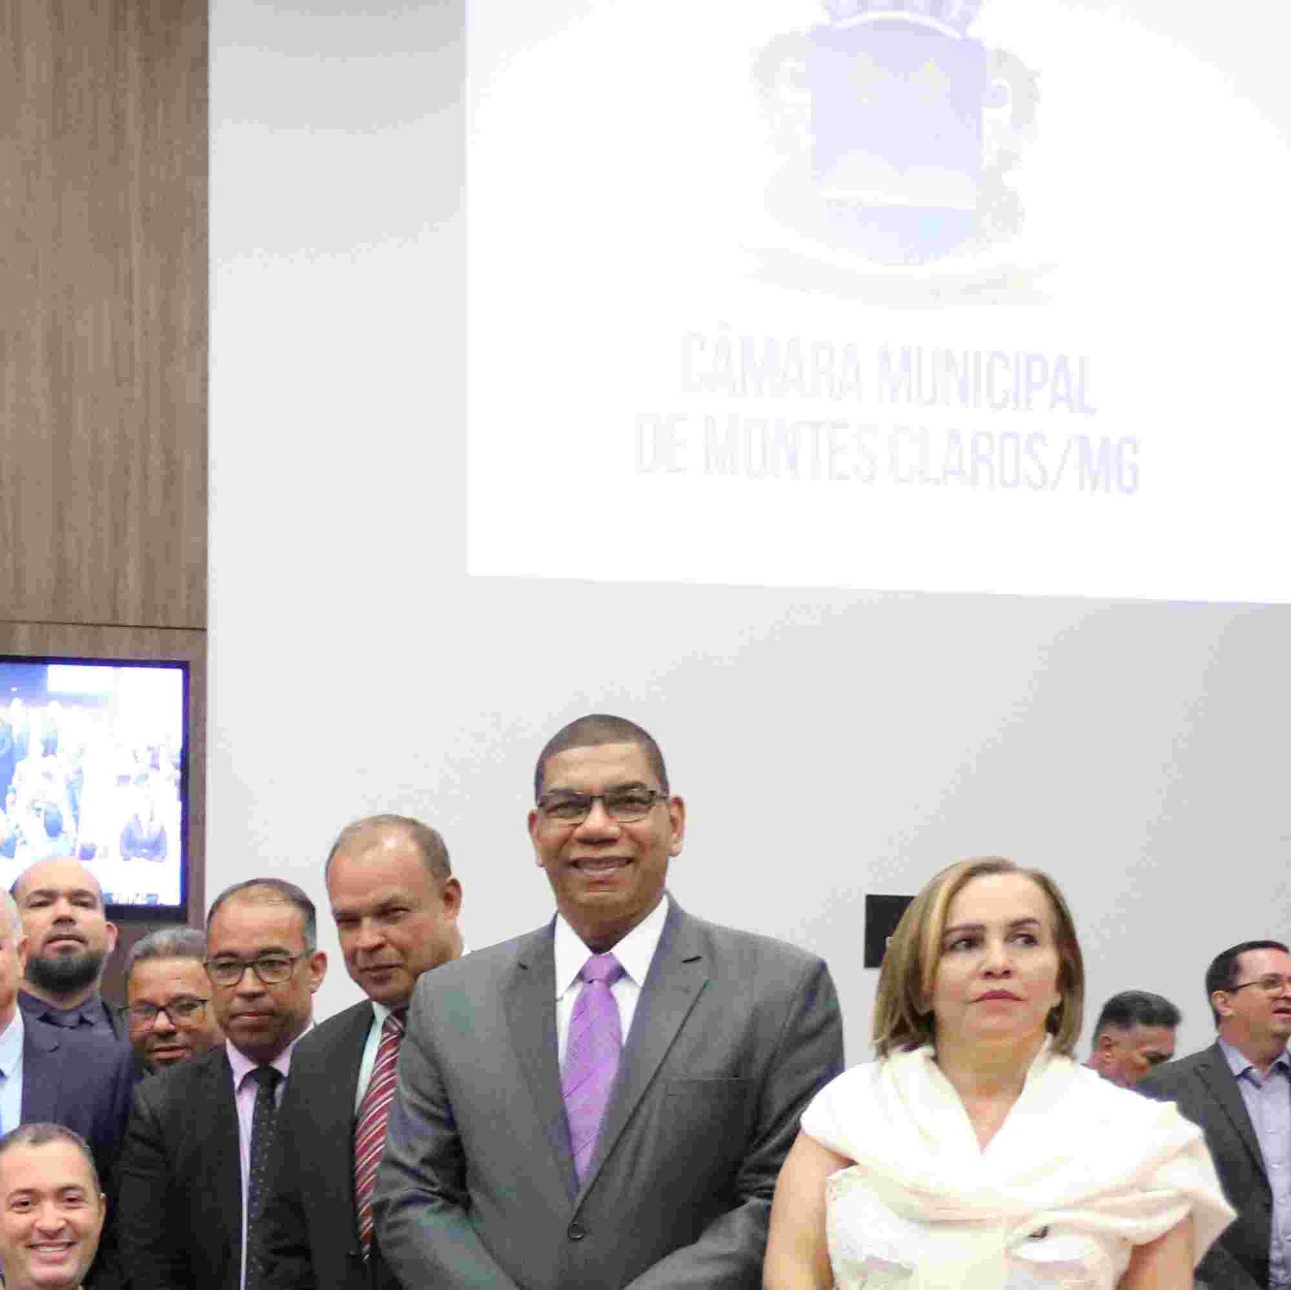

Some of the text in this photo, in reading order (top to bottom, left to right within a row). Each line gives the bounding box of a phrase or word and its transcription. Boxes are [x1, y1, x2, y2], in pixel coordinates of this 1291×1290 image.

[681, 320, 1099, 416] CÂMARA MUNICIPAL
[635, 412, 688, 475] DE
[702, 415, 879, 484] MONTES
